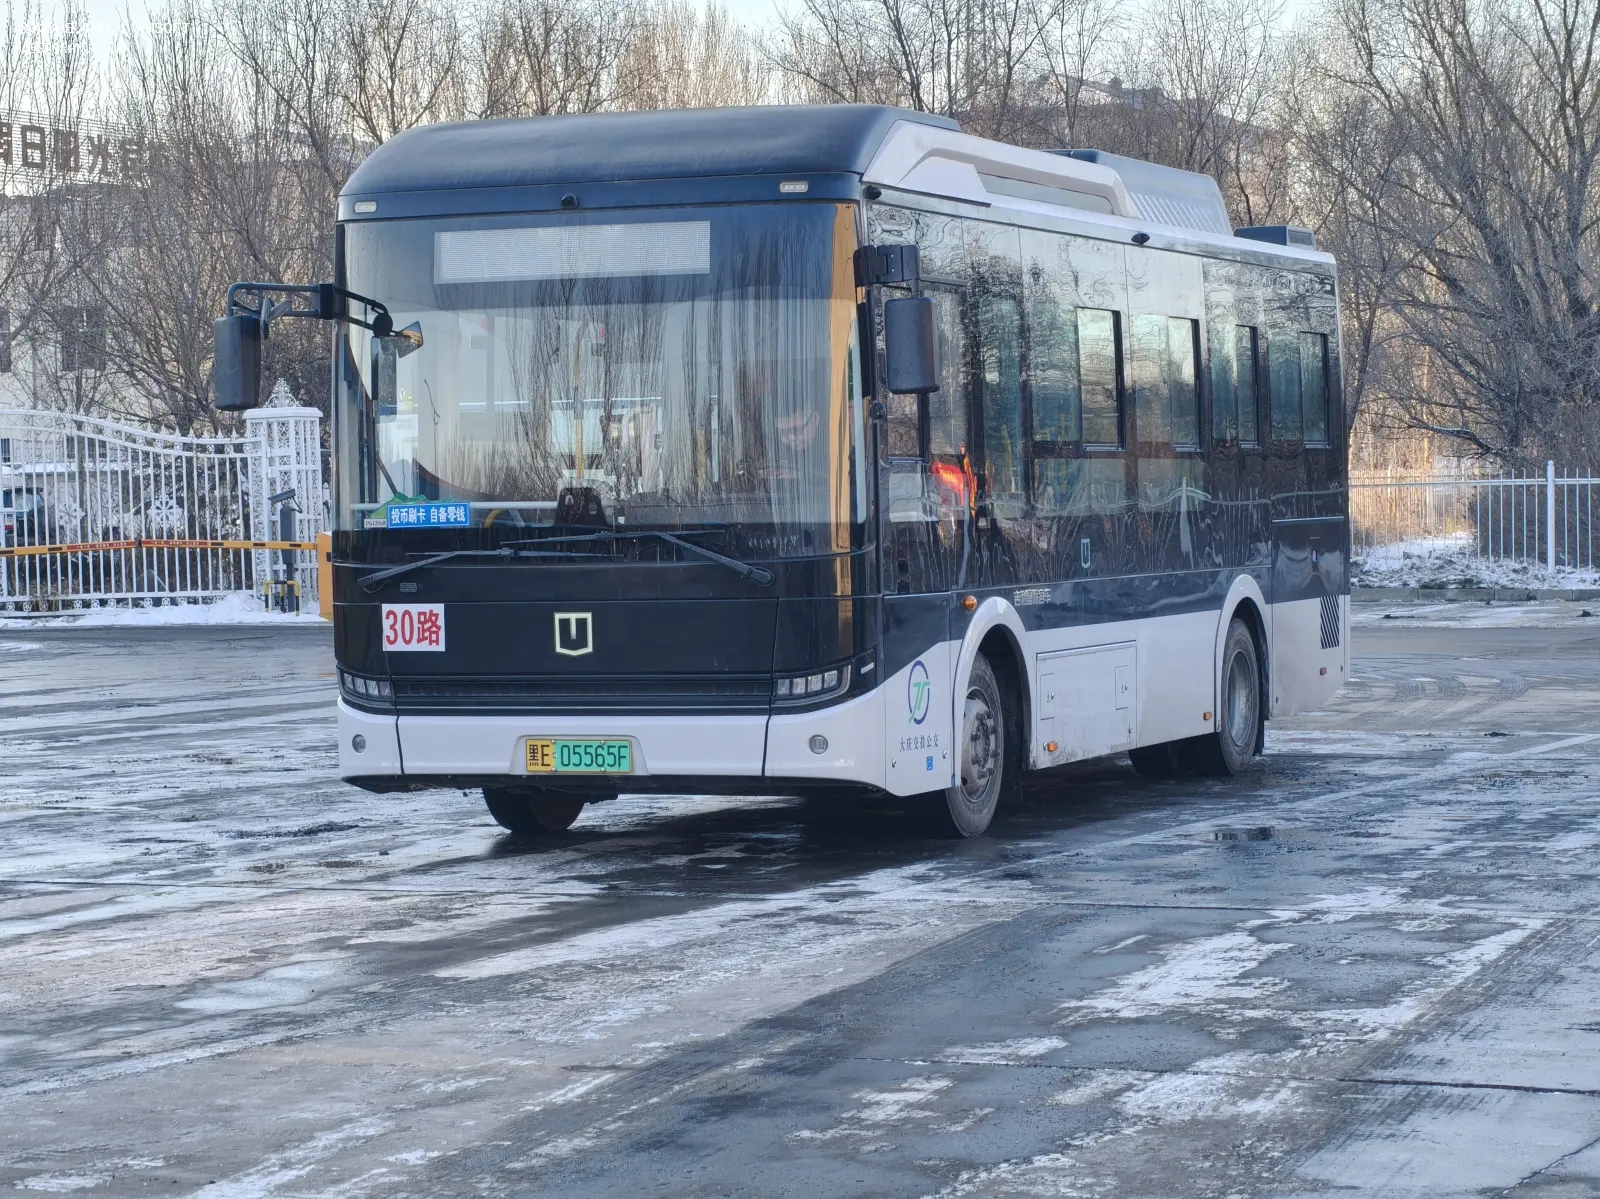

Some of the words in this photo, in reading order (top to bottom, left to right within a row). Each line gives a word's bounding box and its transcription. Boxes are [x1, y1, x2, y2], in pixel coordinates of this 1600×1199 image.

[391, 507, 426, 524] 投币刷卡
[430, 506, 466, 523] 自备零钱
[385, 609, 441, 646] 30路
[560, 744, 628, 768] 05565F
